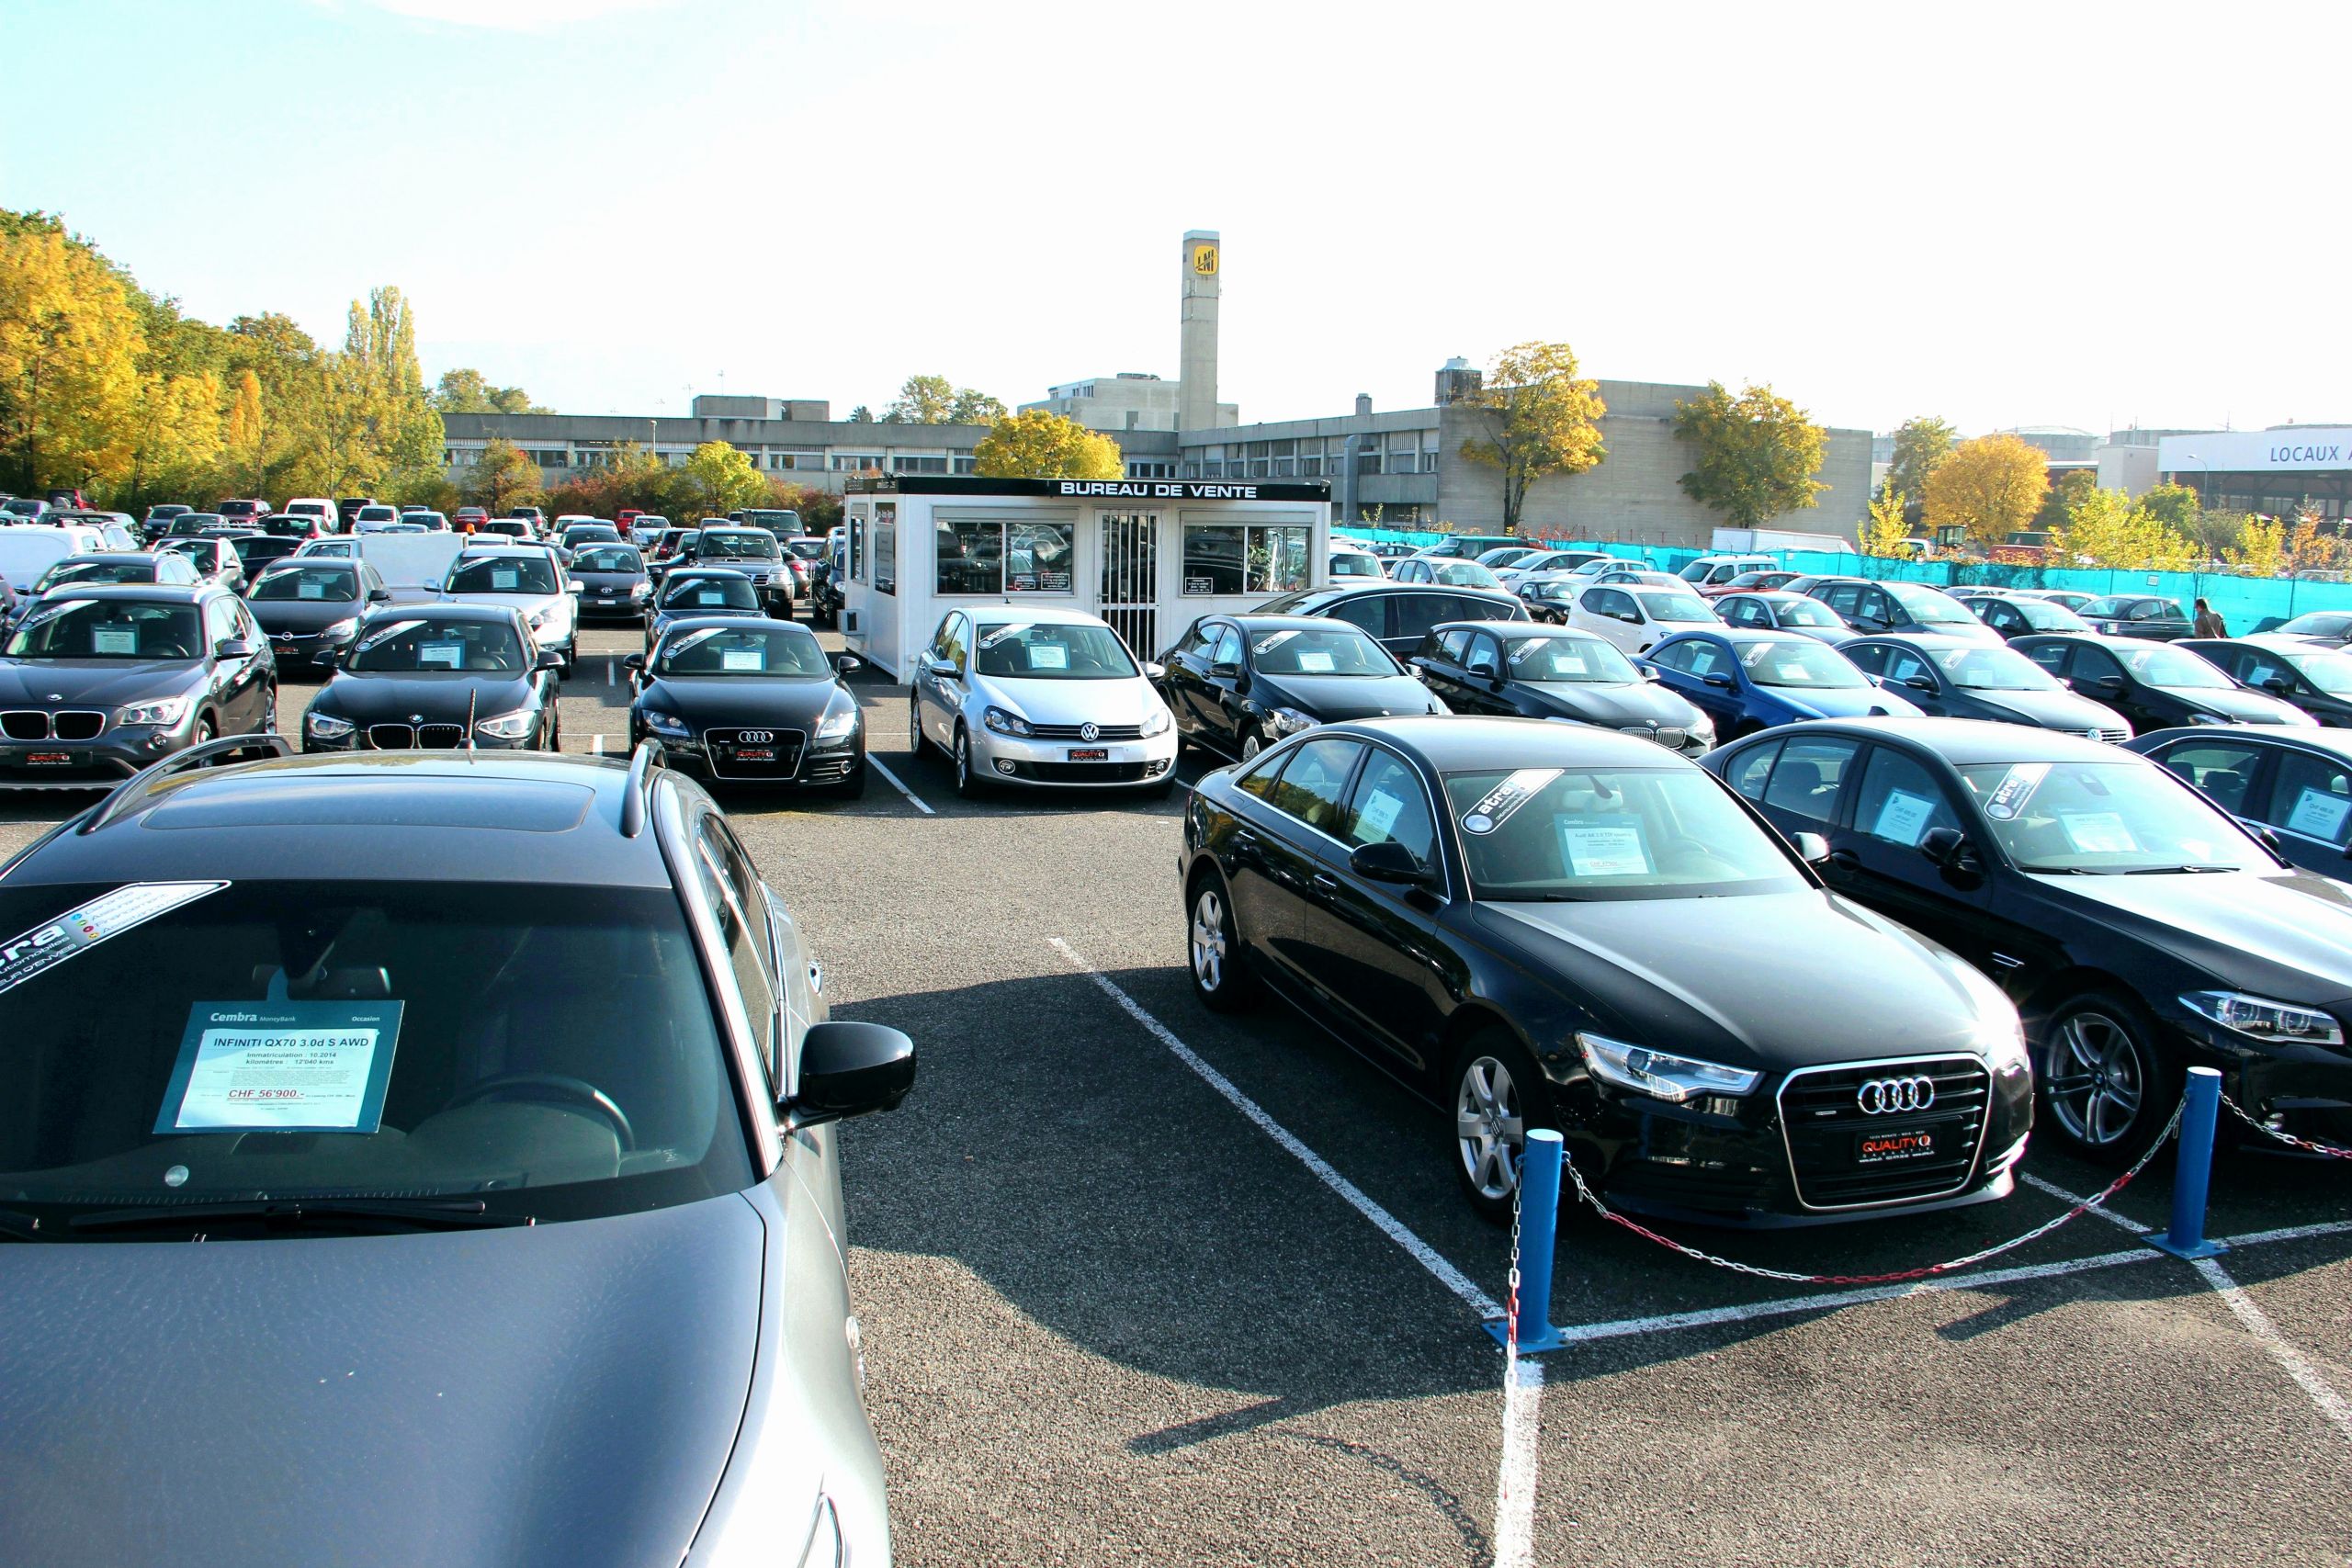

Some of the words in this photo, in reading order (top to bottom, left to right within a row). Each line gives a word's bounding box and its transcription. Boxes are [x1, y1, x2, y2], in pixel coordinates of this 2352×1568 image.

[2270, 446, 2339, 462] LOCAUX
[1060, 481, 1148, 496] BUREAU
[1155, 484, 1182, 497] DE
[1191, 485, 1257, 499] VENTE
[1996, 779, 2019, 804] atra
[1478, 786, 1514, 815] atra
[210, 1012, 257, 1021] Cembra
[213, 1038, 262, 1047] INFINITI
[265, 1038, 296, 1047] QX70
[300, 1038, 324, 1047] 3.0d
[328, 1038, 335, 1046] S
[340, 1038, 369, 1046] AWD
[229, 1089, 255, 1098] CHF
[258, 1089, 305, 1098] 56'900.-
[1862, 1137, 1917, 1152] QUALITY
